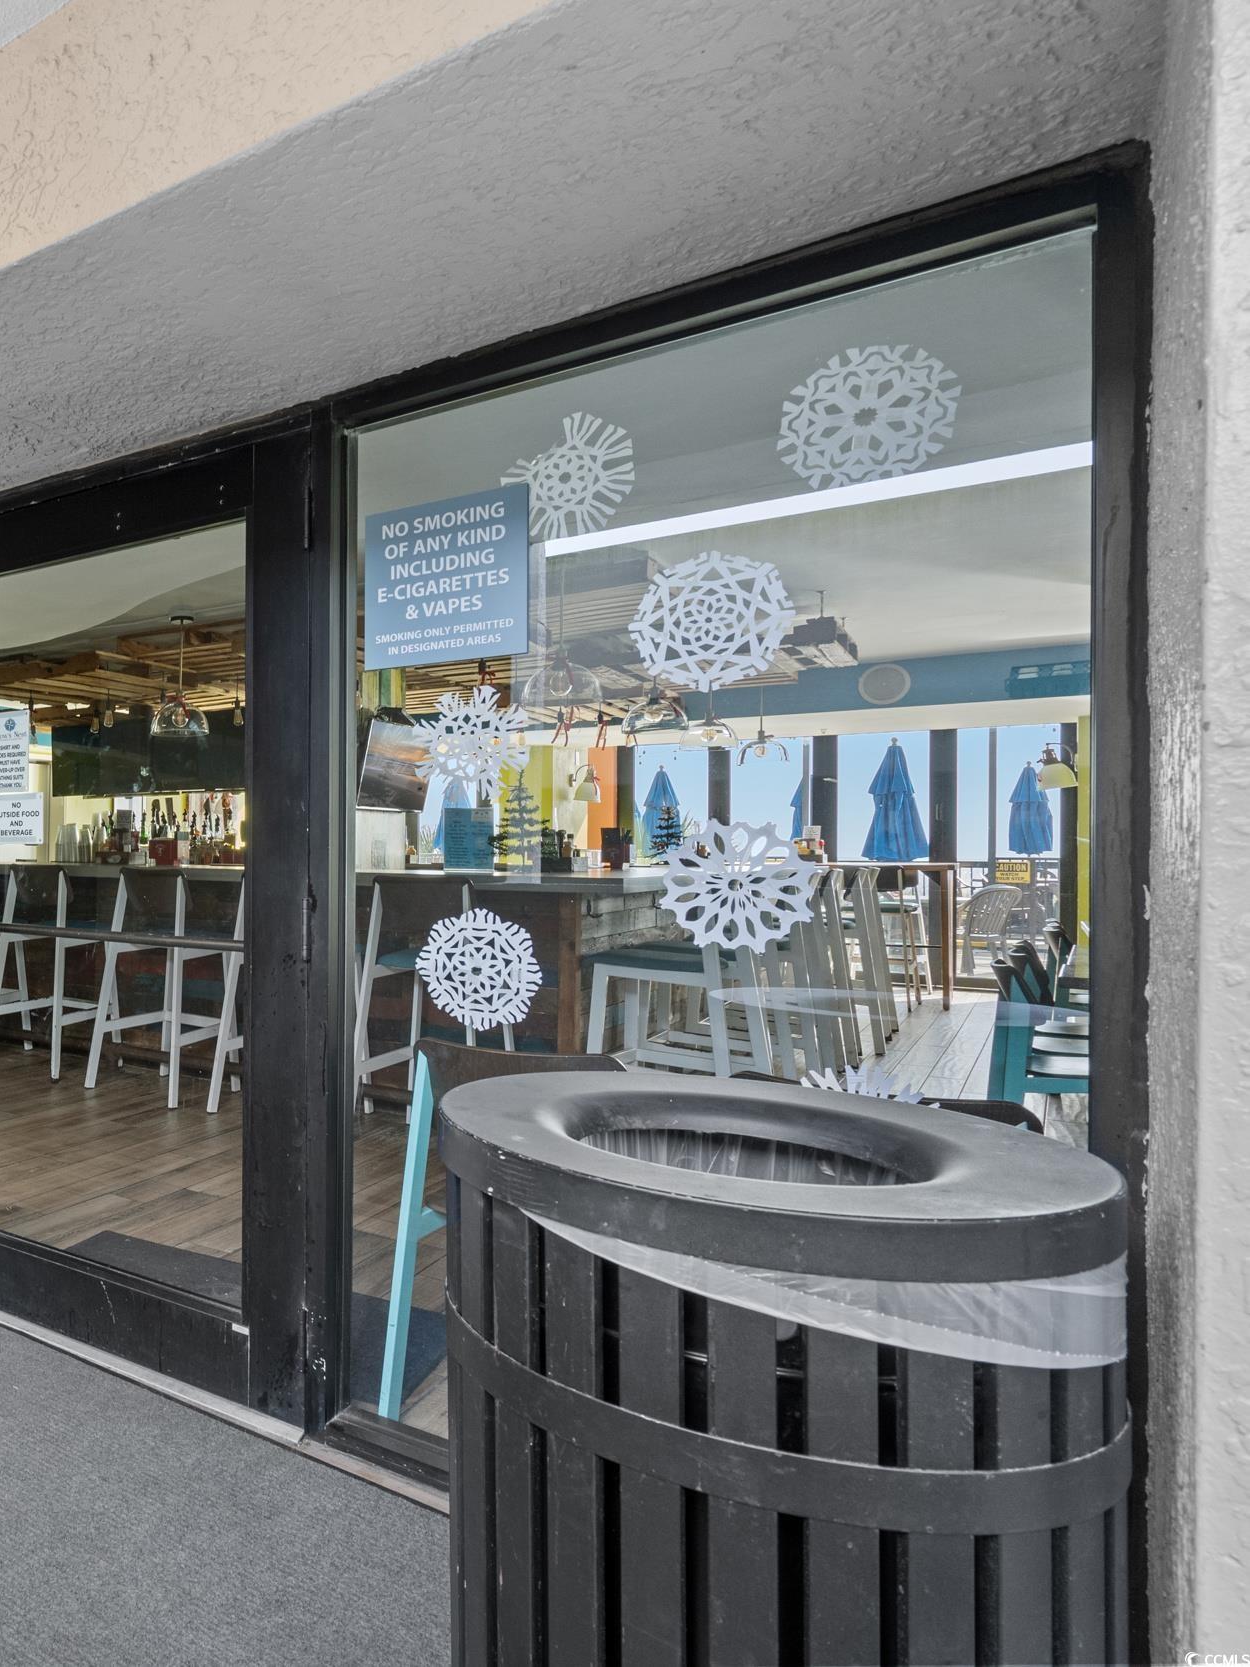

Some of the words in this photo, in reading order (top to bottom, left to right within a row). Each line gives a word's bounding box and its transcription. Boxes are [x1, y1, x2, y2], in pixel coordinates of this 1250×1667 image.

[382, 521, 408, 540] NO
[413, 501, 505, 534] SMOKING
[384, 542, 408, 560] OF
[413, 533, 452, 555] ANY
[457, 524, 506, 547] KIND
[390, 548, 495, 580] INCLUDING
[377, 568, 510, 603] E-CIGARETTES
[405, 604, 418, 620] &
[422, 594, 483, 617] VAPES
[375, 630, 422, 644] SMOKING
[423, 626, 451, 637] ONLY
[453, 617, 514, 634] PERMITTED
[387, 646, 399, 655] IN
[400, 638, 464, 654] DESIGNATED
[466, 633, 502, 646] AREAS
